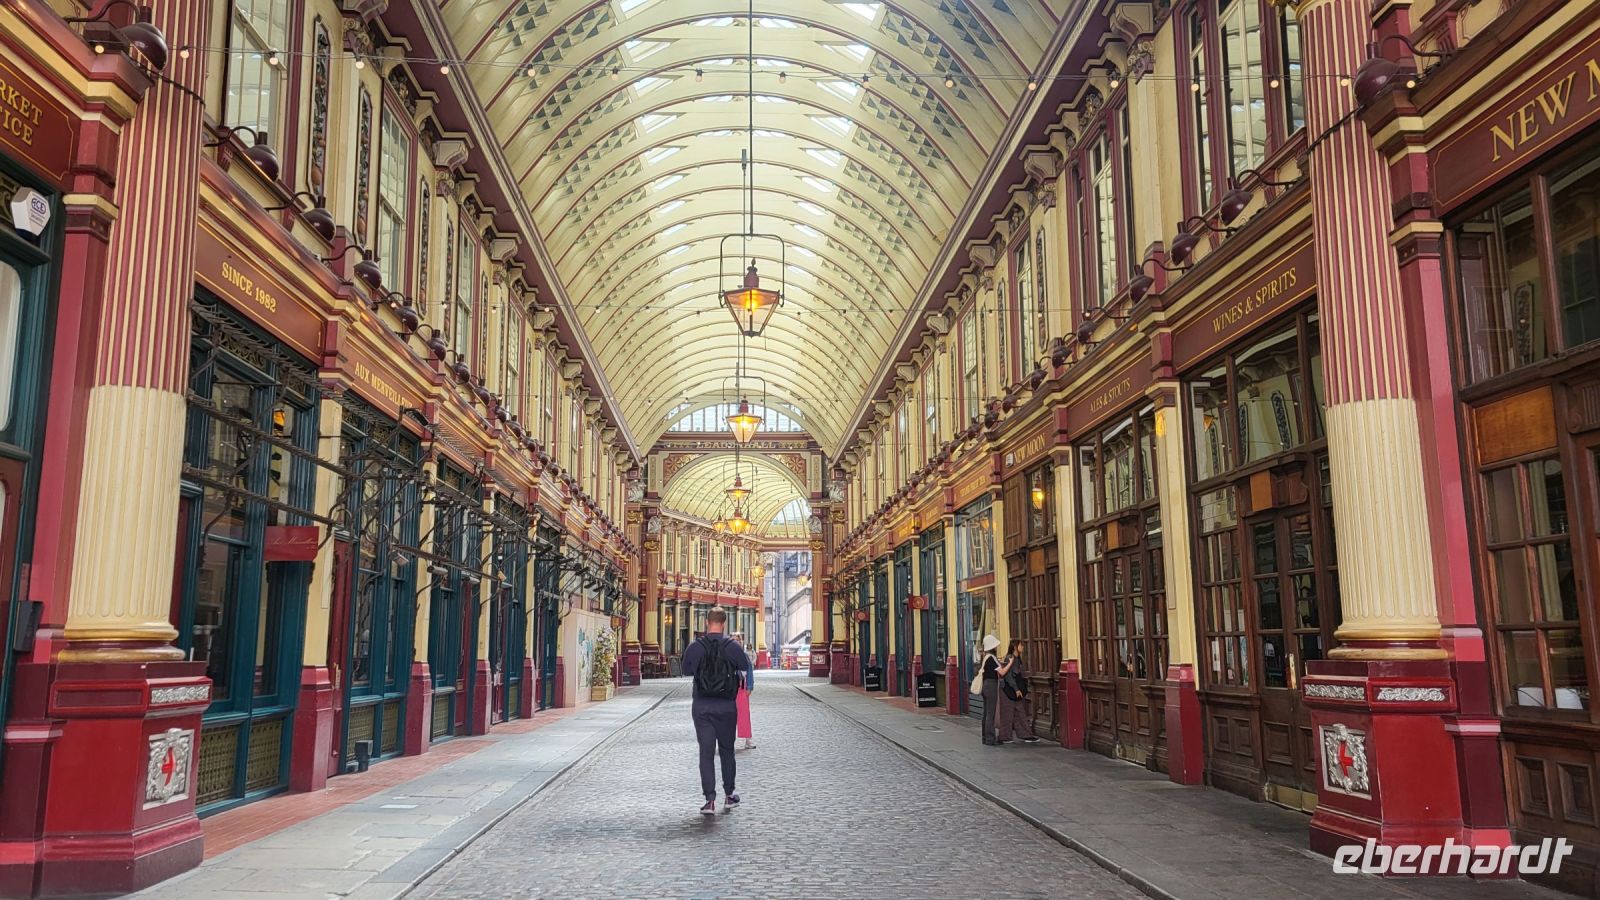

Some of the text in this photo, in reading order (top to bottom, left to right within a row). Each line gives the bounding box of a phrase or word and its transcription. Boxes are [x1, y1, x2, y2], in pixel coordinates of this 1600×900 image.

[0, 106, 33, 146] ICE
[1489, 70, 1578, 162] NEW
[222, 261, 277, 313] SINCE 1982
[1212, 267, 1297, 334] WINES & SPIRITS
[354, 361, 370, 385] AUX
[1089, 378, 1131, 415] ALES & STOUTS
[1014, 444, 1027, 464] NEW
[1026, 433, 1046, 459] MOON
